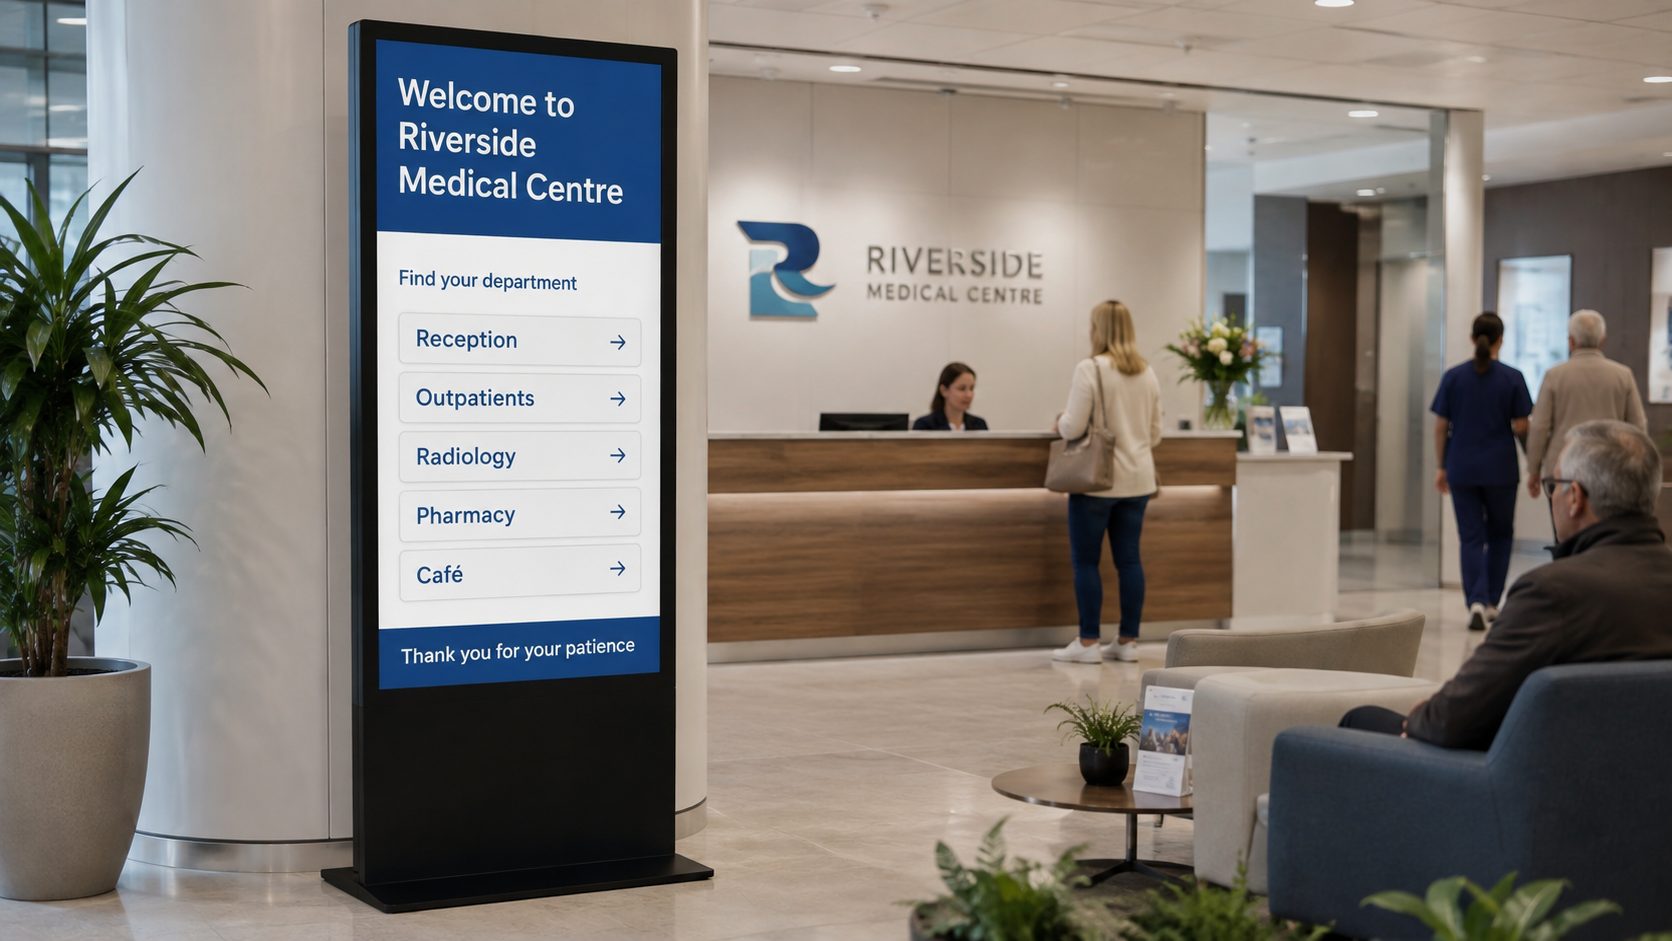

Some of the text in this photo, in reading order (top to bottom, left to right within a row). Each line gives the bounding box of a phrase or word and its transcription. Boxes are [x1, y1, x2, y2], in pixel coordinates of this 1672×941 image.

[398, 77, 575, 118] Welcome to
[399, 121, 537, 158] Riverside
[399, 165, 624, 205] Medical Centre
[867, 245, 1043, 279] RIVERSIDE
[399, 269, 578, 292] Find your department
[867, 283, 1043, 305] MEDICAL CENTRE
[416, 328, 518, 352] Reception
[416, 388, 535, 411] Outpatients
[416, 446, 516, 470] Radiology
[416, 506, 516, 527] Pharmacy
[416, 564, 464, 585] Café
[401, 638, 636, 665] Thank you for your patience
